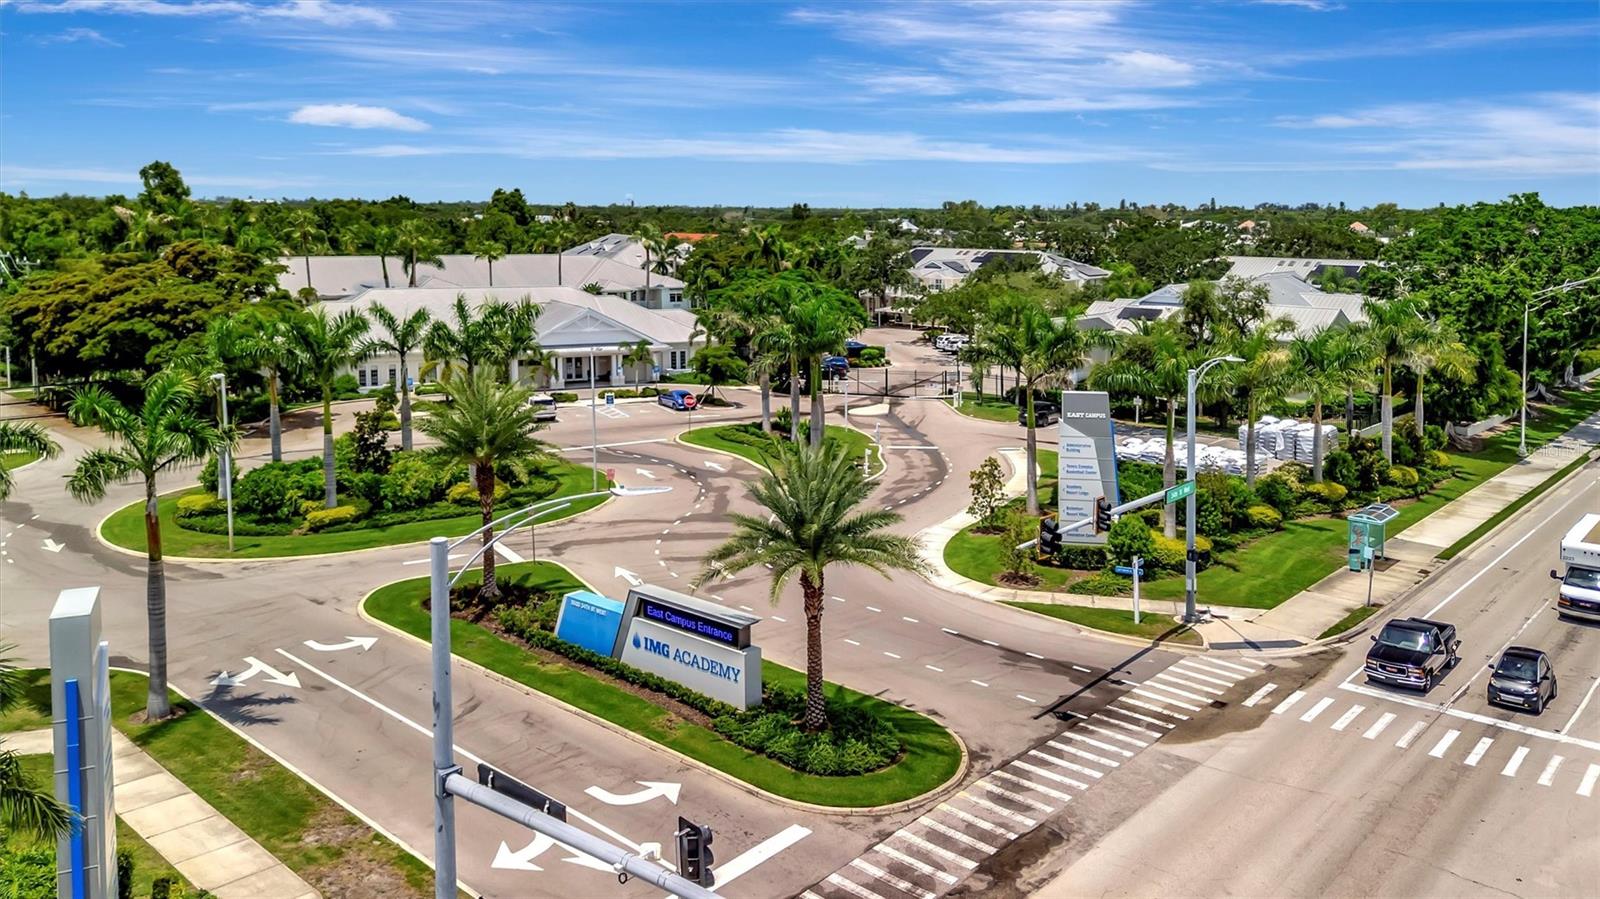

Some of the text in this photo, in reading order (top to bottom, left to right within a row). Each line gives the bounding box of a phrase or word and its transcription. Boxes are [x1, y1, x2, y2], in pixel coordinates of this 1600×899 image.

[647, 605, 733, 641] East Campus Entrance
[643, 636, 741, 683] IMG ACADEMY
